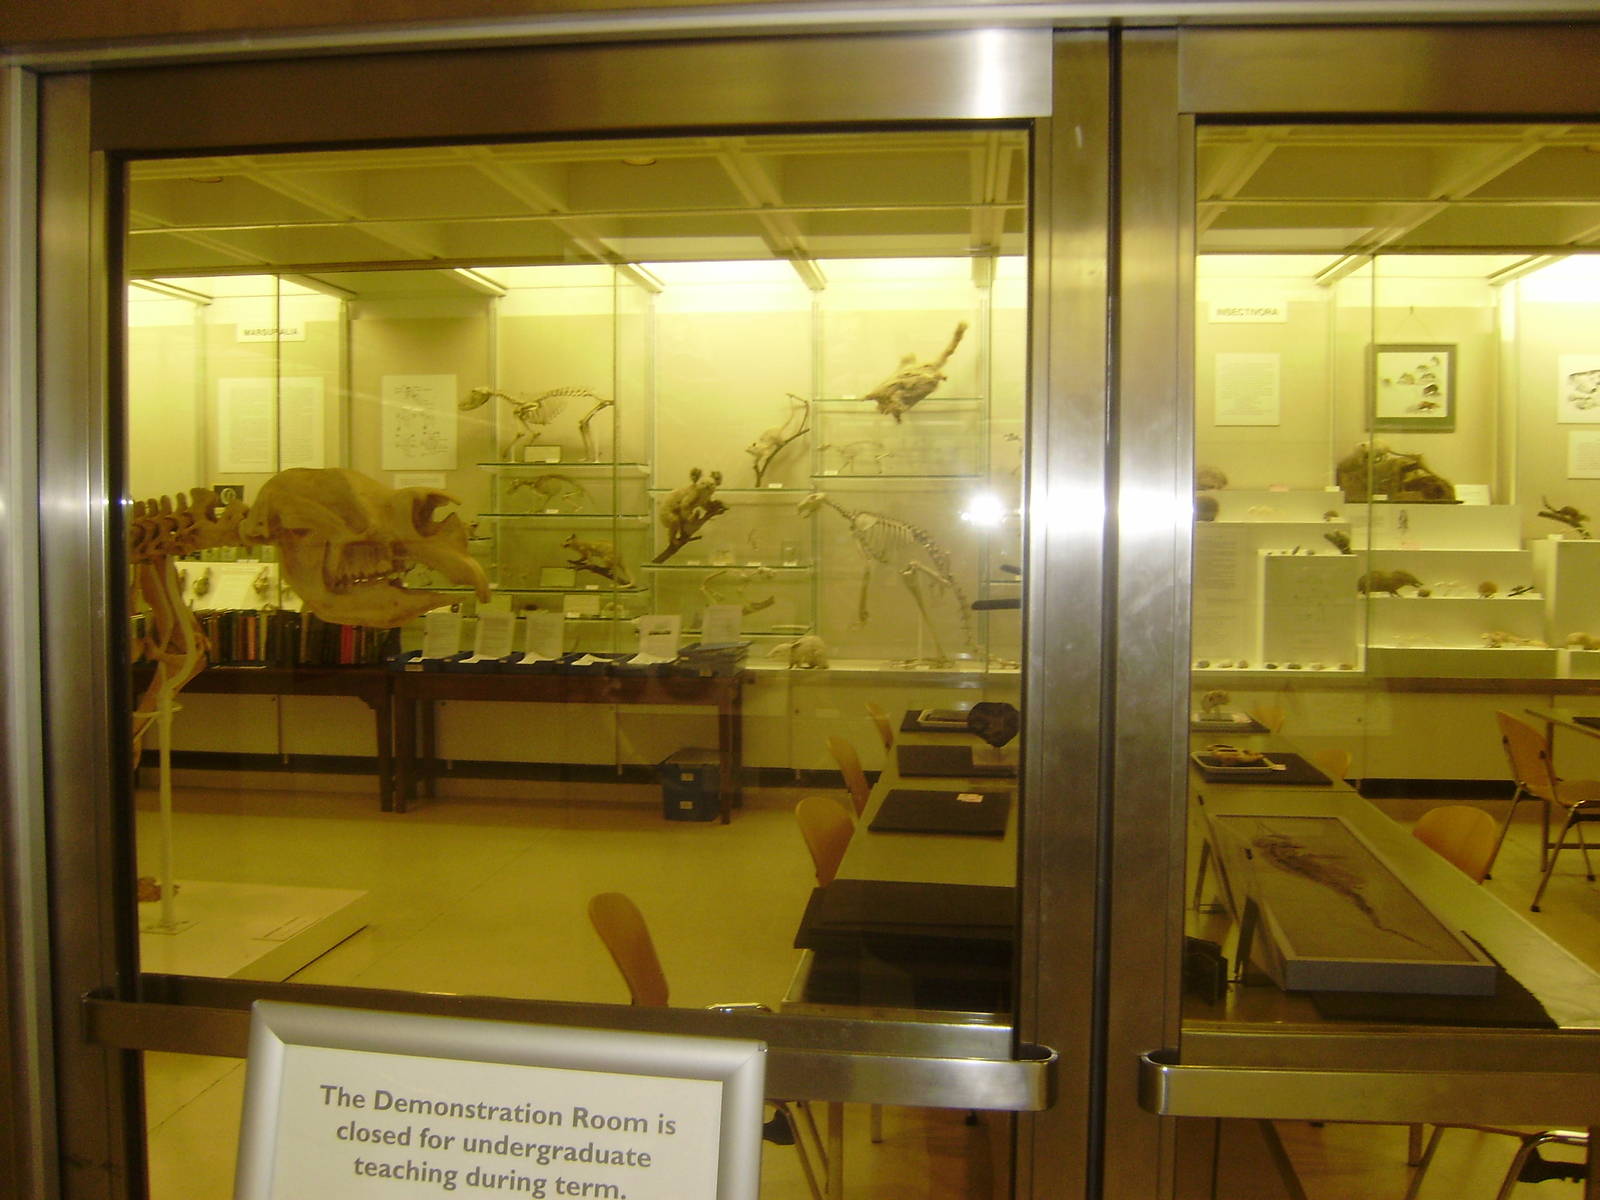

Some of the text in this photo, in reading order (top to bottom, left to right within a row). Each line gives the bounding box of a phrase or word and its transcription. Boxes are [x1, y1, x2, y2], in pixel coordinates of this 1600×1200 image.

[243, 328, 298, 336] MARSUPALIA
[320, 1084, 677, 1135] The Demonstration Room is
[336, 1120, 652, 1167] closed for undergraduate
[354, 1157, 626, 1200] teaching during term.
